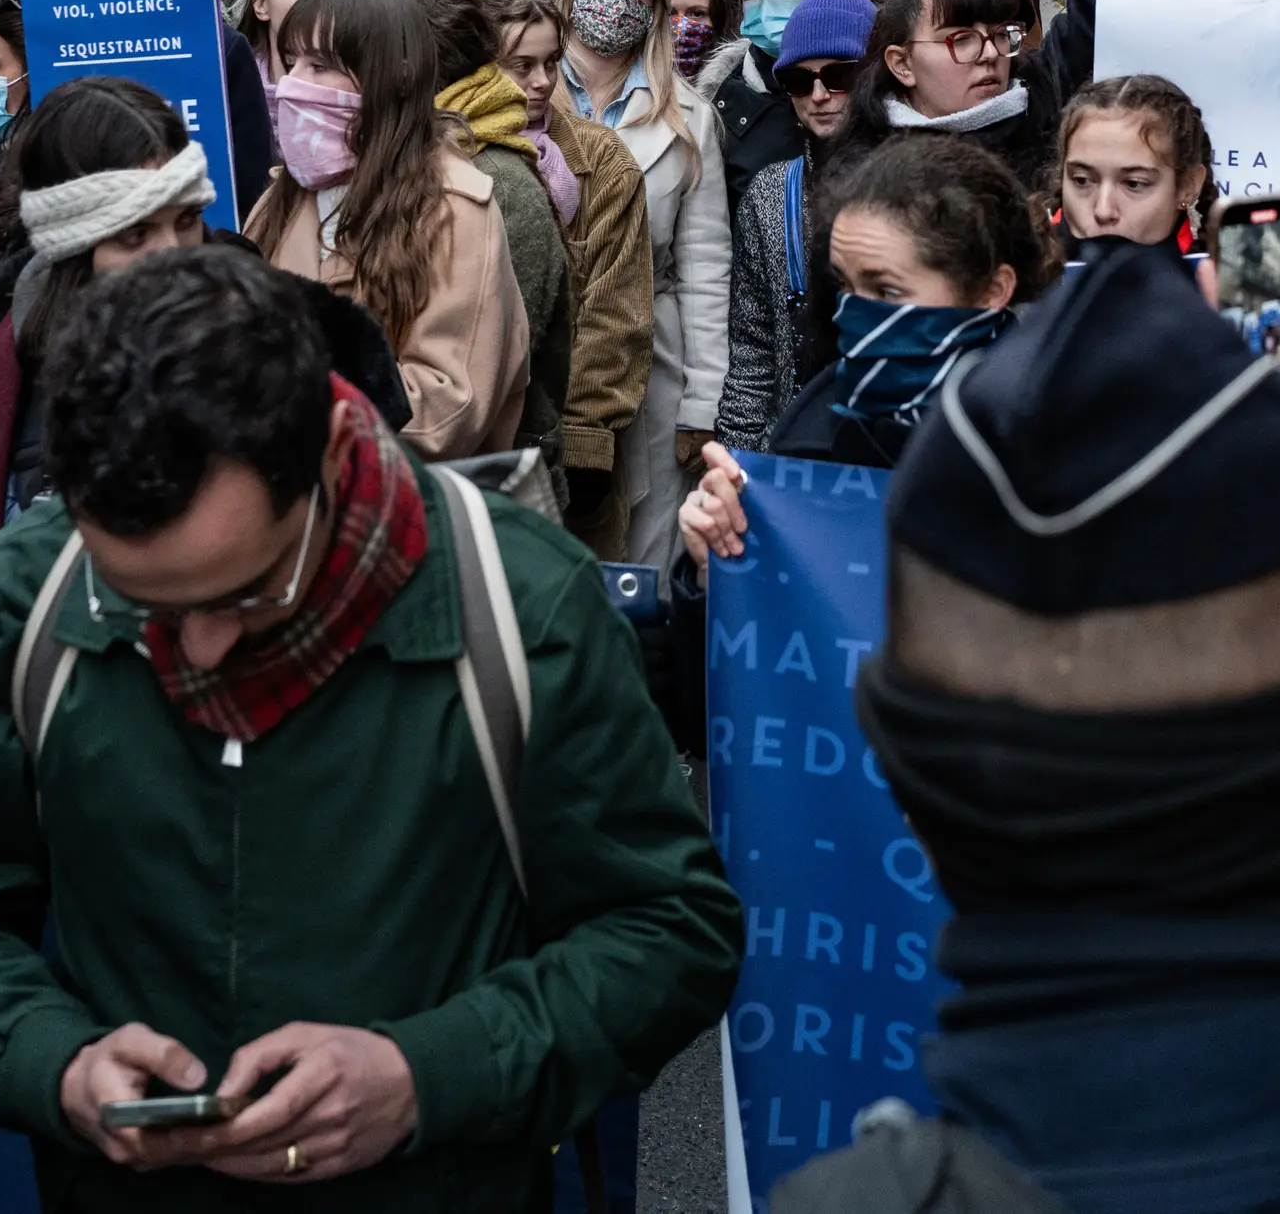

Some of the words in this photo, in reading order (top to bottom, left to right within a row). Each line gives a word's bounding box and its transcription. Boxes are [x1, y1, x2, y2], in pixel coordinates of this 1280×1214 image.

[53, 3, 94, 19] VIOL,
[59, 36, 182, 59] SEQUESTRATION
[1252, 151, 1268, 169] A
